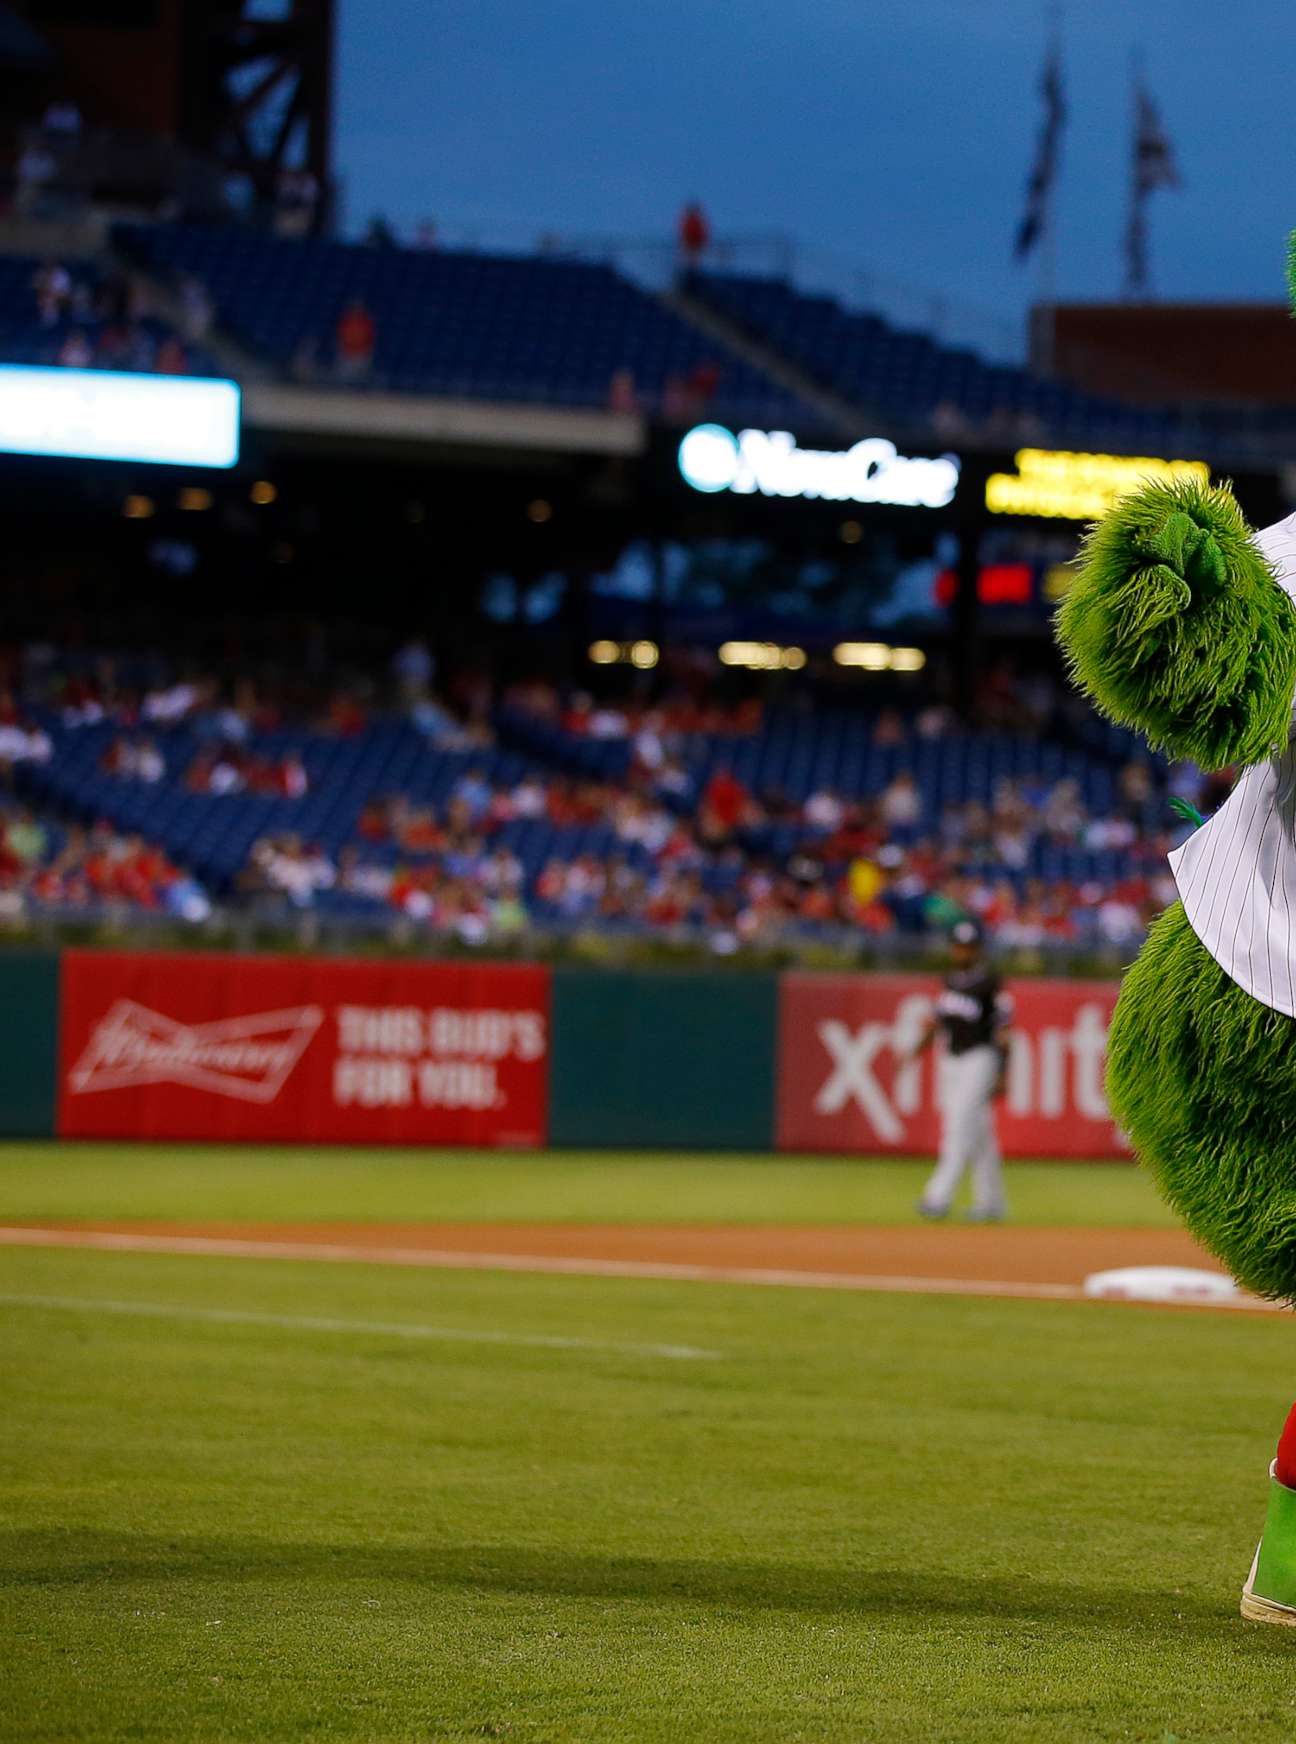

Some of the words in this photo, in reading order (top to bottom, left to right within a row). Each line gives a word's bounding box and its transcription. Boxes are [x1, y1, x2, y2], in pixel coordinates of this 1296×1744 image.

[338, 1005, 423, 1054] THIS
[430, 1009, 546, 1060] BUD'S
[333, 1055, 414, 1105] FOR
